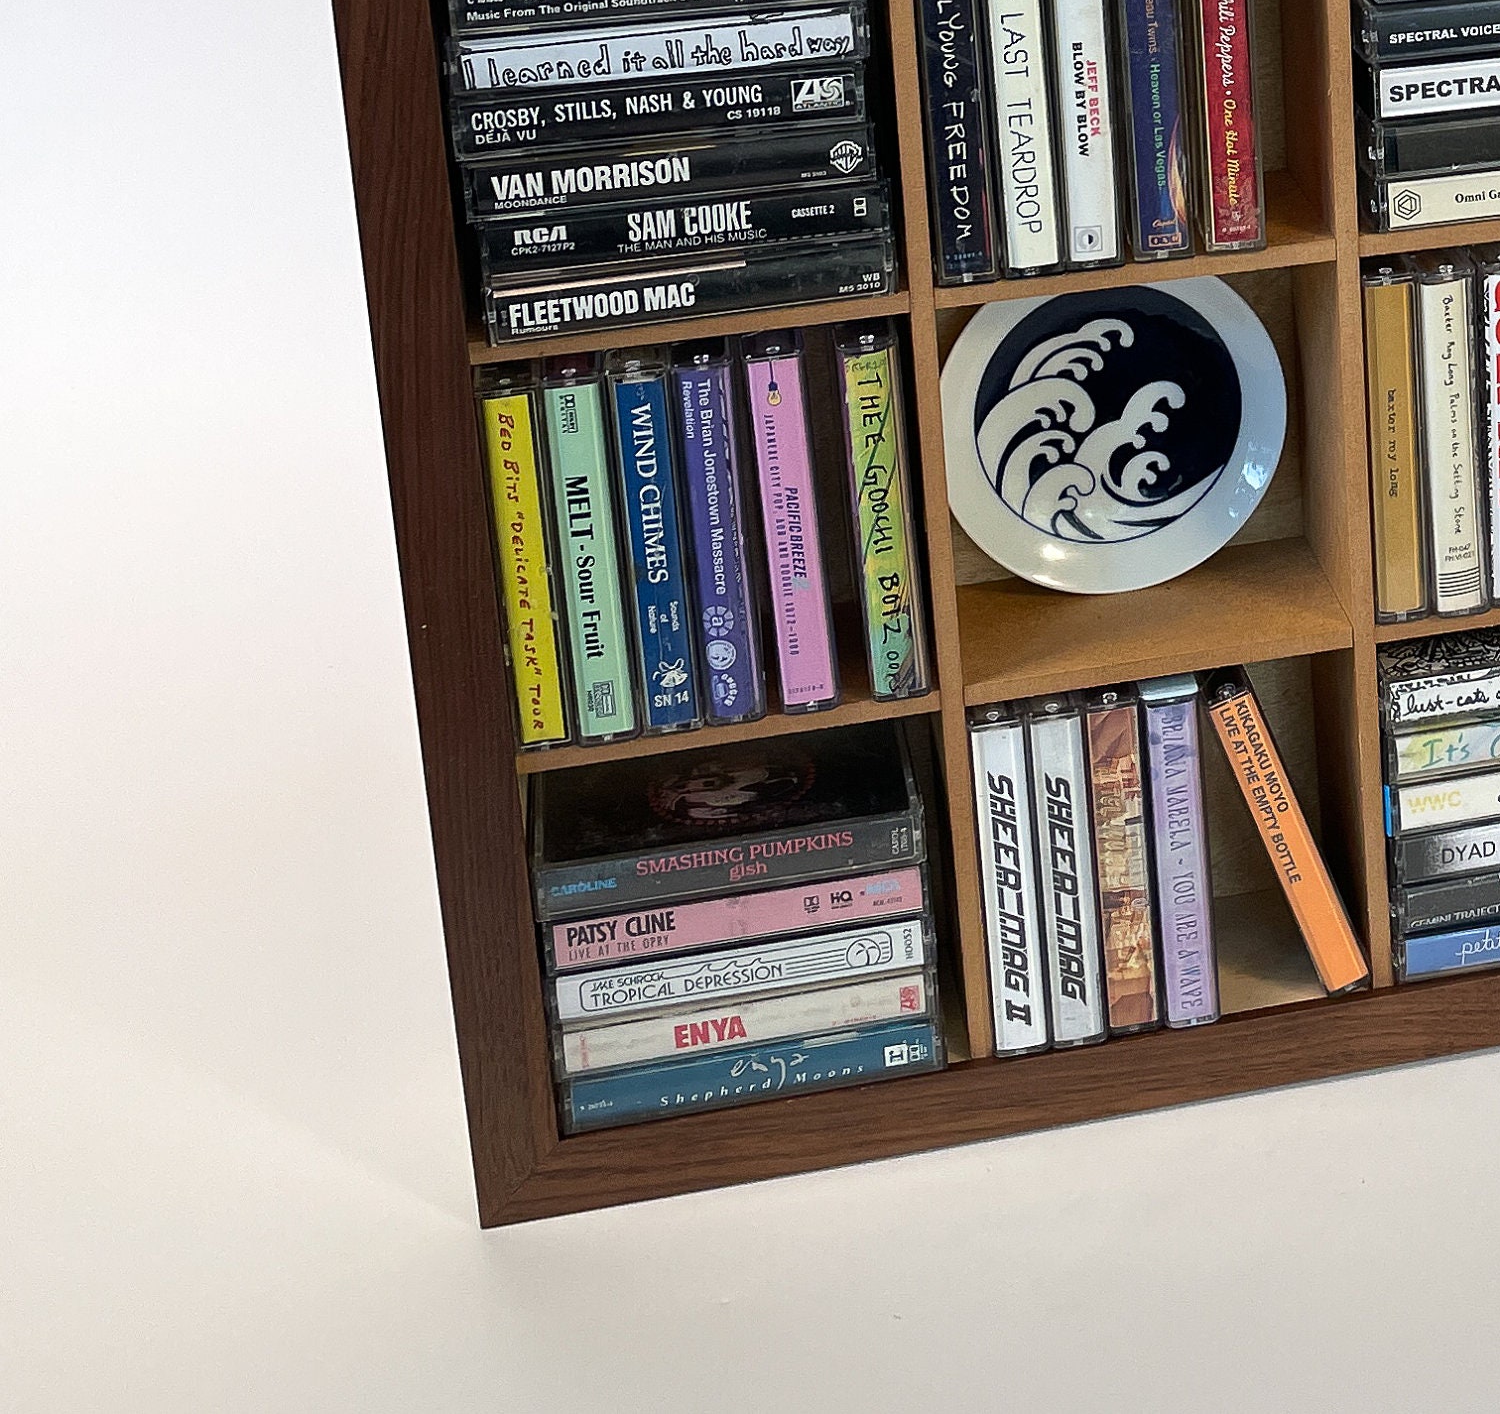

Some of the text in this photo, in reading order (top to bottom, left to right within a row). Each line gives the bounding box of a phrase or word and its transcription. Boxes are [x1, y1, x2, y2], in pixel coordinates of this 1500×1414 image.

[467, 9, 500, 22] Music
[503, 7, 534, 18] From
[539, 4, 559, 15] The
[563, 0, 609, 15] Original
[1001, 12, 1029, 78] LAST
[1389, 24, 1500, 44] SPECTRAL VOICE
[471, 85, 762, 132] CROSBY, STILLS, NASH & YOUNG
[1072, 41, 1090, 157] BLOW BY BLOW
[1086, 60, 1101, 136] JEFF BECK
[491, 156, 690, 201] VAN MORRISON
[1007, 98, 1043, 235] TEARDROP
[494, 195, 567, 209] MOONDANCE
[1455, 191, 1486, 204] Omni
[617, 228, 767, 254] THE MAN AND HIS MUSIC
[627, 200, 752, 241] SAM COOKE
[509, 283, 695, 328] FLEETWOOD MAC
[681, 381, 695, 439] Revelation
[630, 402, 670, 585] WIND CHIMES
[697, 380, 726, 595] The Brian Jonestown Massacre
[565, 474, 604, 659] MELT Sour Fruit
[654, 693, 689, 707] SN 14
[1234, 700, 1289, 814] KIKAGAKU MOYO
[1220, 708, 1301, 884] LIVE AT THE EMPTY BOTTLE
[636, 832, 854, 876] SMASHING PUMPKINS
[729, 862, 767, 881] gish
[1441, 841, 1496, 864] DYAD
[567, 912, 675, 946] PATSY CLINE
[591, 964, 783, 1007] TROPICAL DEPRESSION
[675, 1016, 747, 1048] ENYA
